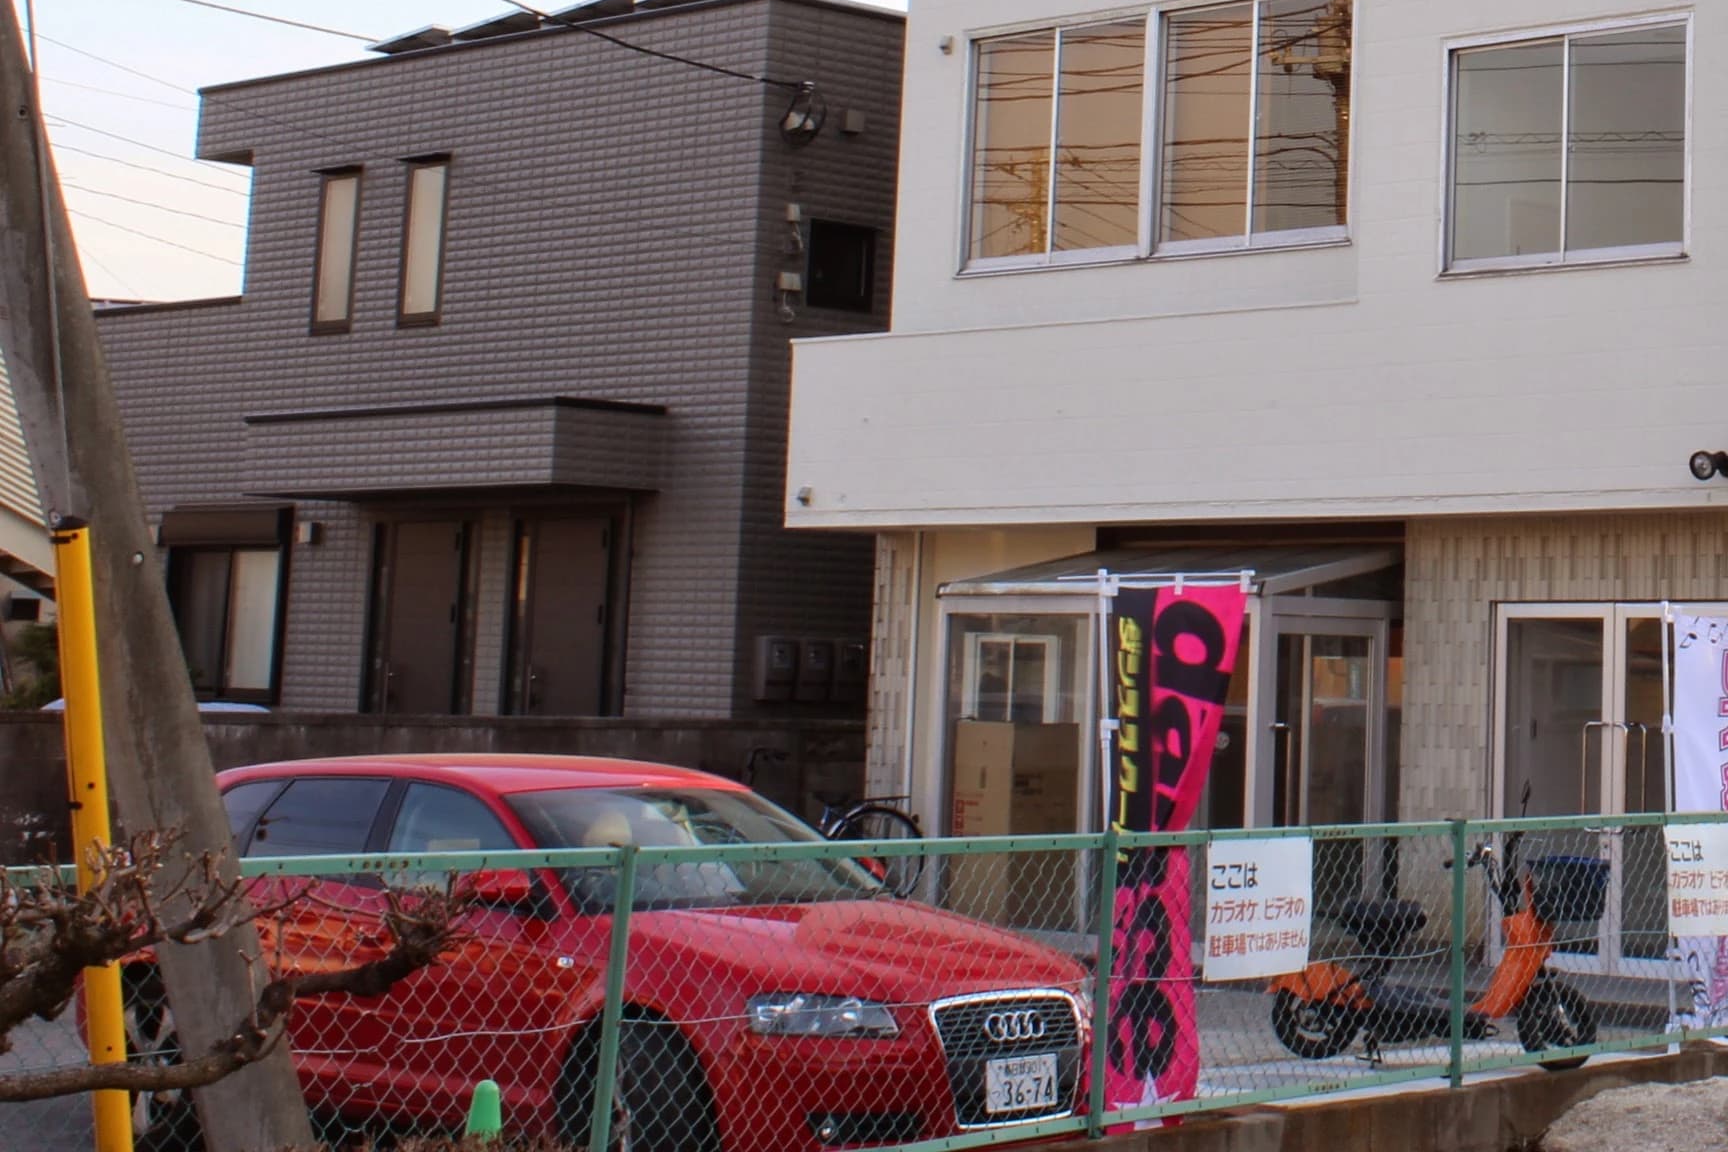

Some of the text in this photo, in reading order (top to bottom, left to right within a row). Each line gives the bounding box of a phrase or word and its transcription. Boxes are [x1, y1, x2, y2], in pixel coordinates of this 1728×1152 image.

[1669, 839, 1704, 862] ここは
[1211, 862, 1258, 890] ここは
[1208, 929, 1308, 958] 駐車場ではありません
[1003, 1076, 1053, 1106] 36-74
